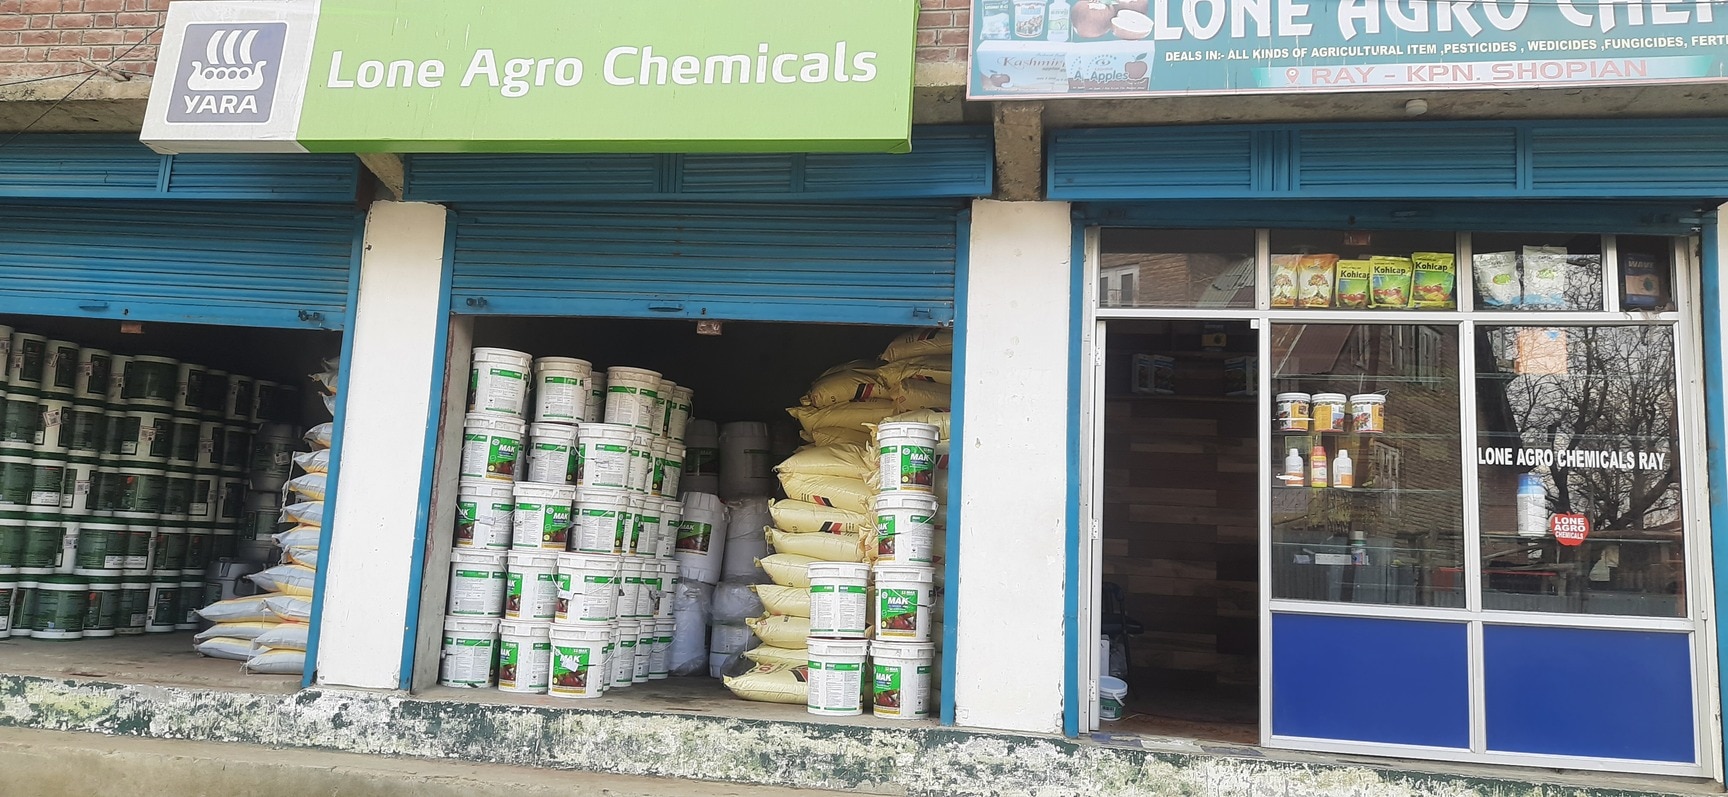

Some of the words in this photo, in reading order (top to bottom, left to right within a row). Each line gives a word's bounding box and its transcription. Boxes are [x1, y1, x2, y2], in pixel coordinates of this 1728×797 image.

[1154, 0, 1313, 41] LONE
[1165, 50, 1202, 61] DEALS
[1227, 49, 1249, 60] ALL
[1252, 48, 1289, 59] KINDS
[1292, 47, 1308, 58] OF
[1311, 45, 1404, 58] AGRICULTURAL
[1407, 44, 1437, 54] ITEM
[1527, 39, 1597, 51] WEDICIDES
[327, 50, 443, 89] Lone
[460, 48, 584, 98] Agro
[602, 41, 878, 86] Chemicals
[1312, 66, 1376, 84] RAY
[1407, 64, 1481, 82] KPN.
[1492, 59, 1647, 80] SHOPIAN
[1090, 70, 1128, 83] Apples
[183, 95, 258, 114] YARA
[499, 444, 516, 453] MAK
[910, 453, 929, 462] MAK
[1478, 447, 1513, 466] LONE
[1517, 448, 1554, 467] AGRO
[1557, 449, 1635, 470] CHEMICALS
[1638, 452, 1666, 471] RAY
[553, 511, 569, 520] MAK
[1554, 517, 1585, 525] LONE
[1554, 524, 1586, 532] AGRO
[1555, 531, 1584, 540] CHEMICALS
[888, 596, 908, 605] MAK
